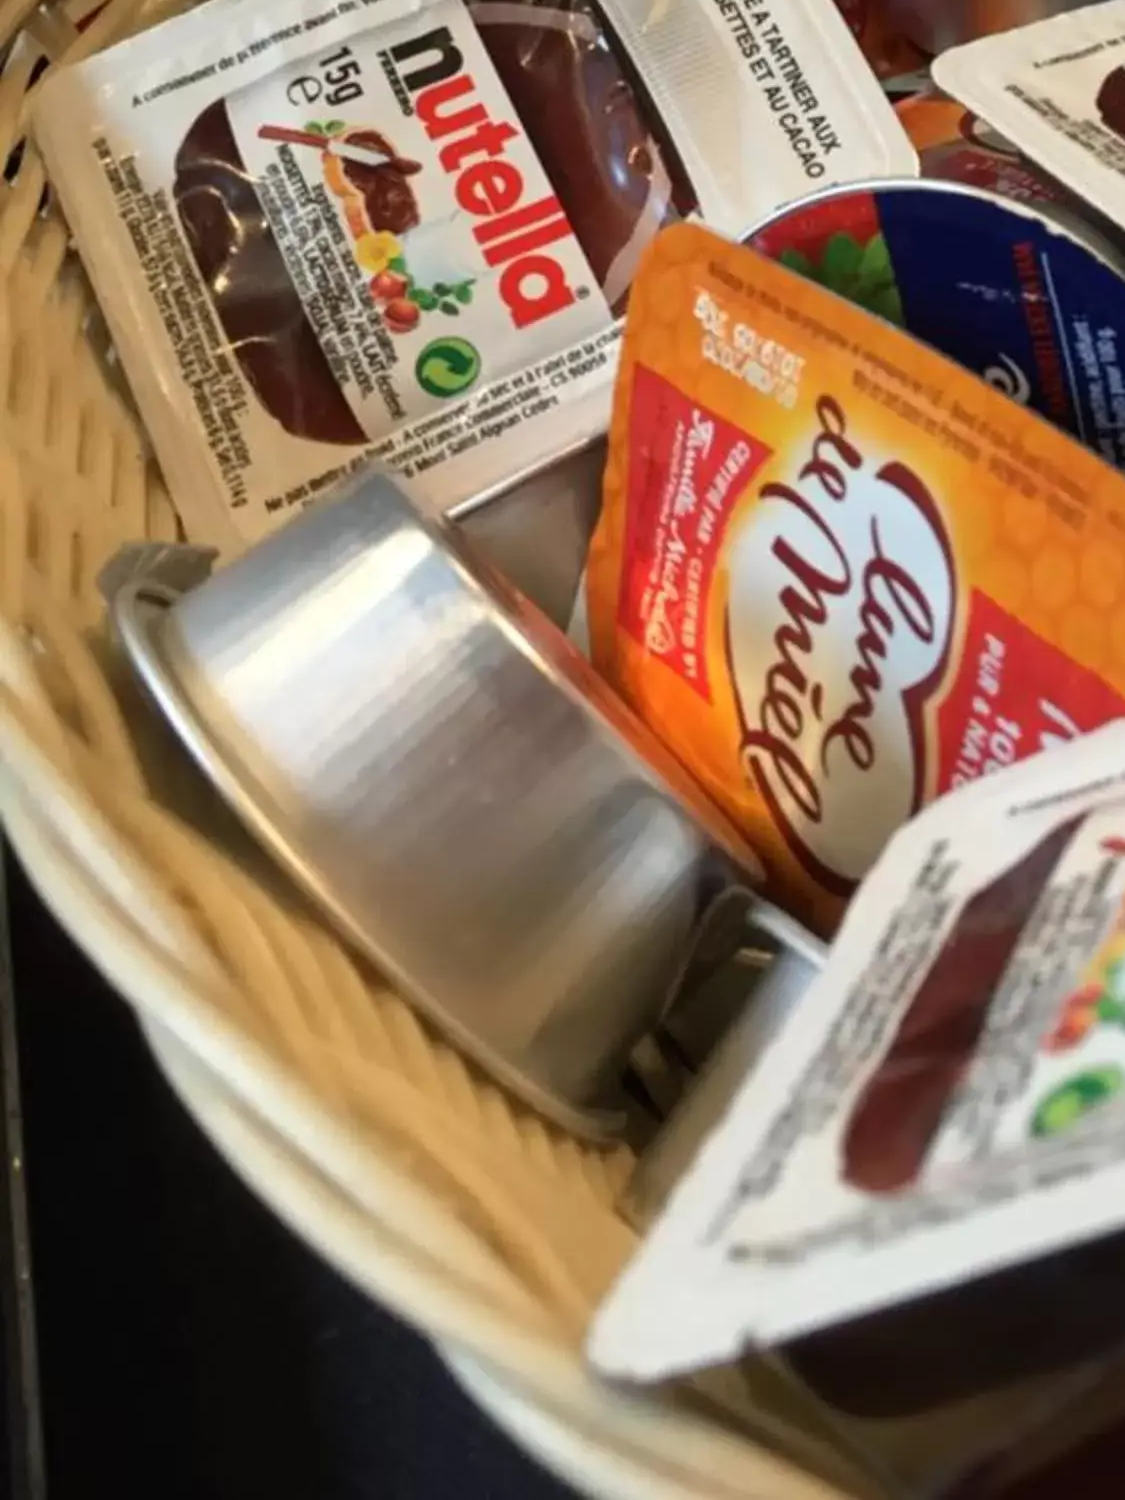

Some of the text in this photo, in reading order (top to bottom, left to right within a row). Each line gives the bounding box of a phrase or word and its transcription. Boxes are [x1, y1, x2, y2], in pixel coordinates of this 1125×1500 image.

[320, 45, 364, 107] 15g
[377, 52, 414, 117] FERRERO
[749, 56, 776, 85] ET
[751, 8, 772, 26] A
[762, 20, 824, 115] TARTINER
[809, 107, 843, 155] AUX
[762, 80, 793, 112] AU
[397, 26, 577, 329] nutella
[779, 109, 826, 179] CACAO
[800, 394, 864, 501] de
